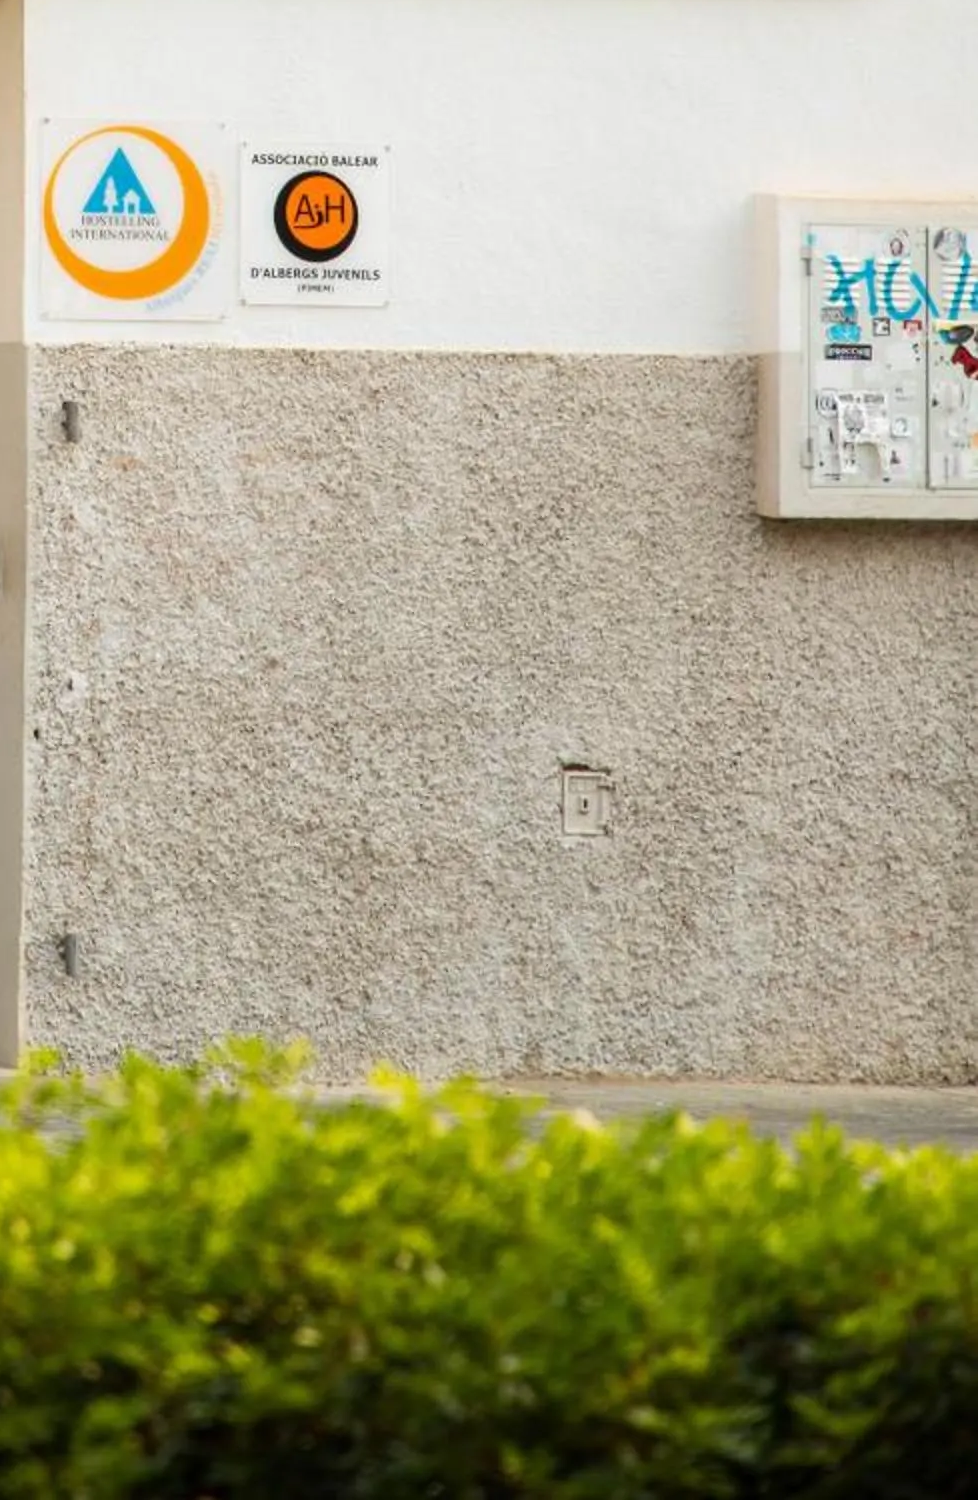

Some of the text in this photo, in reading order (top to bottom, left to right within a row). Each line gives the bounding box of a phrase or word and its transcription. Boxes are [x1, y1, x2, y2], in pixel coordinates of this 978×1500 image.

[331, 155, 379, 168] BALEAR
[81, 214, 160, 228] HOSTELLING
[70, 227, 169, 241] INTERNATIONAL
[251, 267, 381, 281] D'ALBERGS JUVENILS
